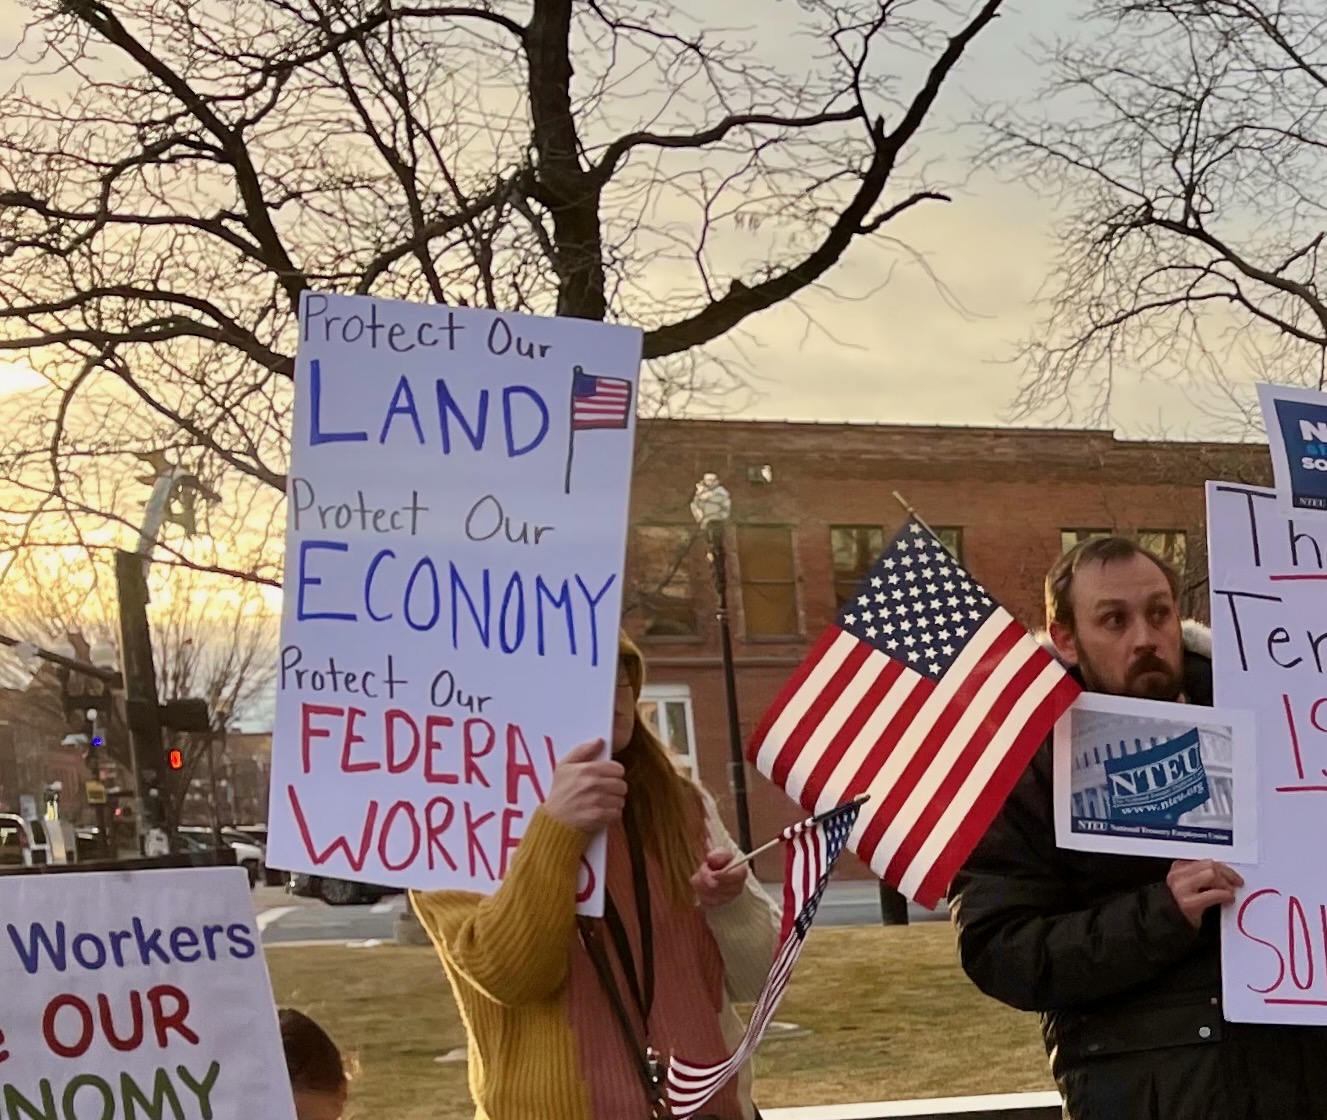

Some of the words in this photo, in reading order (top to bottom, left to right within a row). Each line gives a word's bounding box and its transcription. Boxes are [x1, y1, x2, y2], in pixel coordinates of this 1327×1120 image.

[303, 294, 466, 352] Protect
[487, 317, 552, 359] Our
[309, 358, 550, 458] LAND
[291, 477, 430, 536] Protect
[465, 494, 556, 545] Our
[297, 540, 616, 667] ECONOMY
[280, 645, 408, 699] Protect
[430, 670, 494, 713] Our
[302, 703, 557, 804] FEDERA
[1108, 742, 1201, 797] NTEU
[1078, 819, 1108, 831] NTEU
[6, 917, 256, 974] Workers
[42, 984, 199, 1058] OUR
